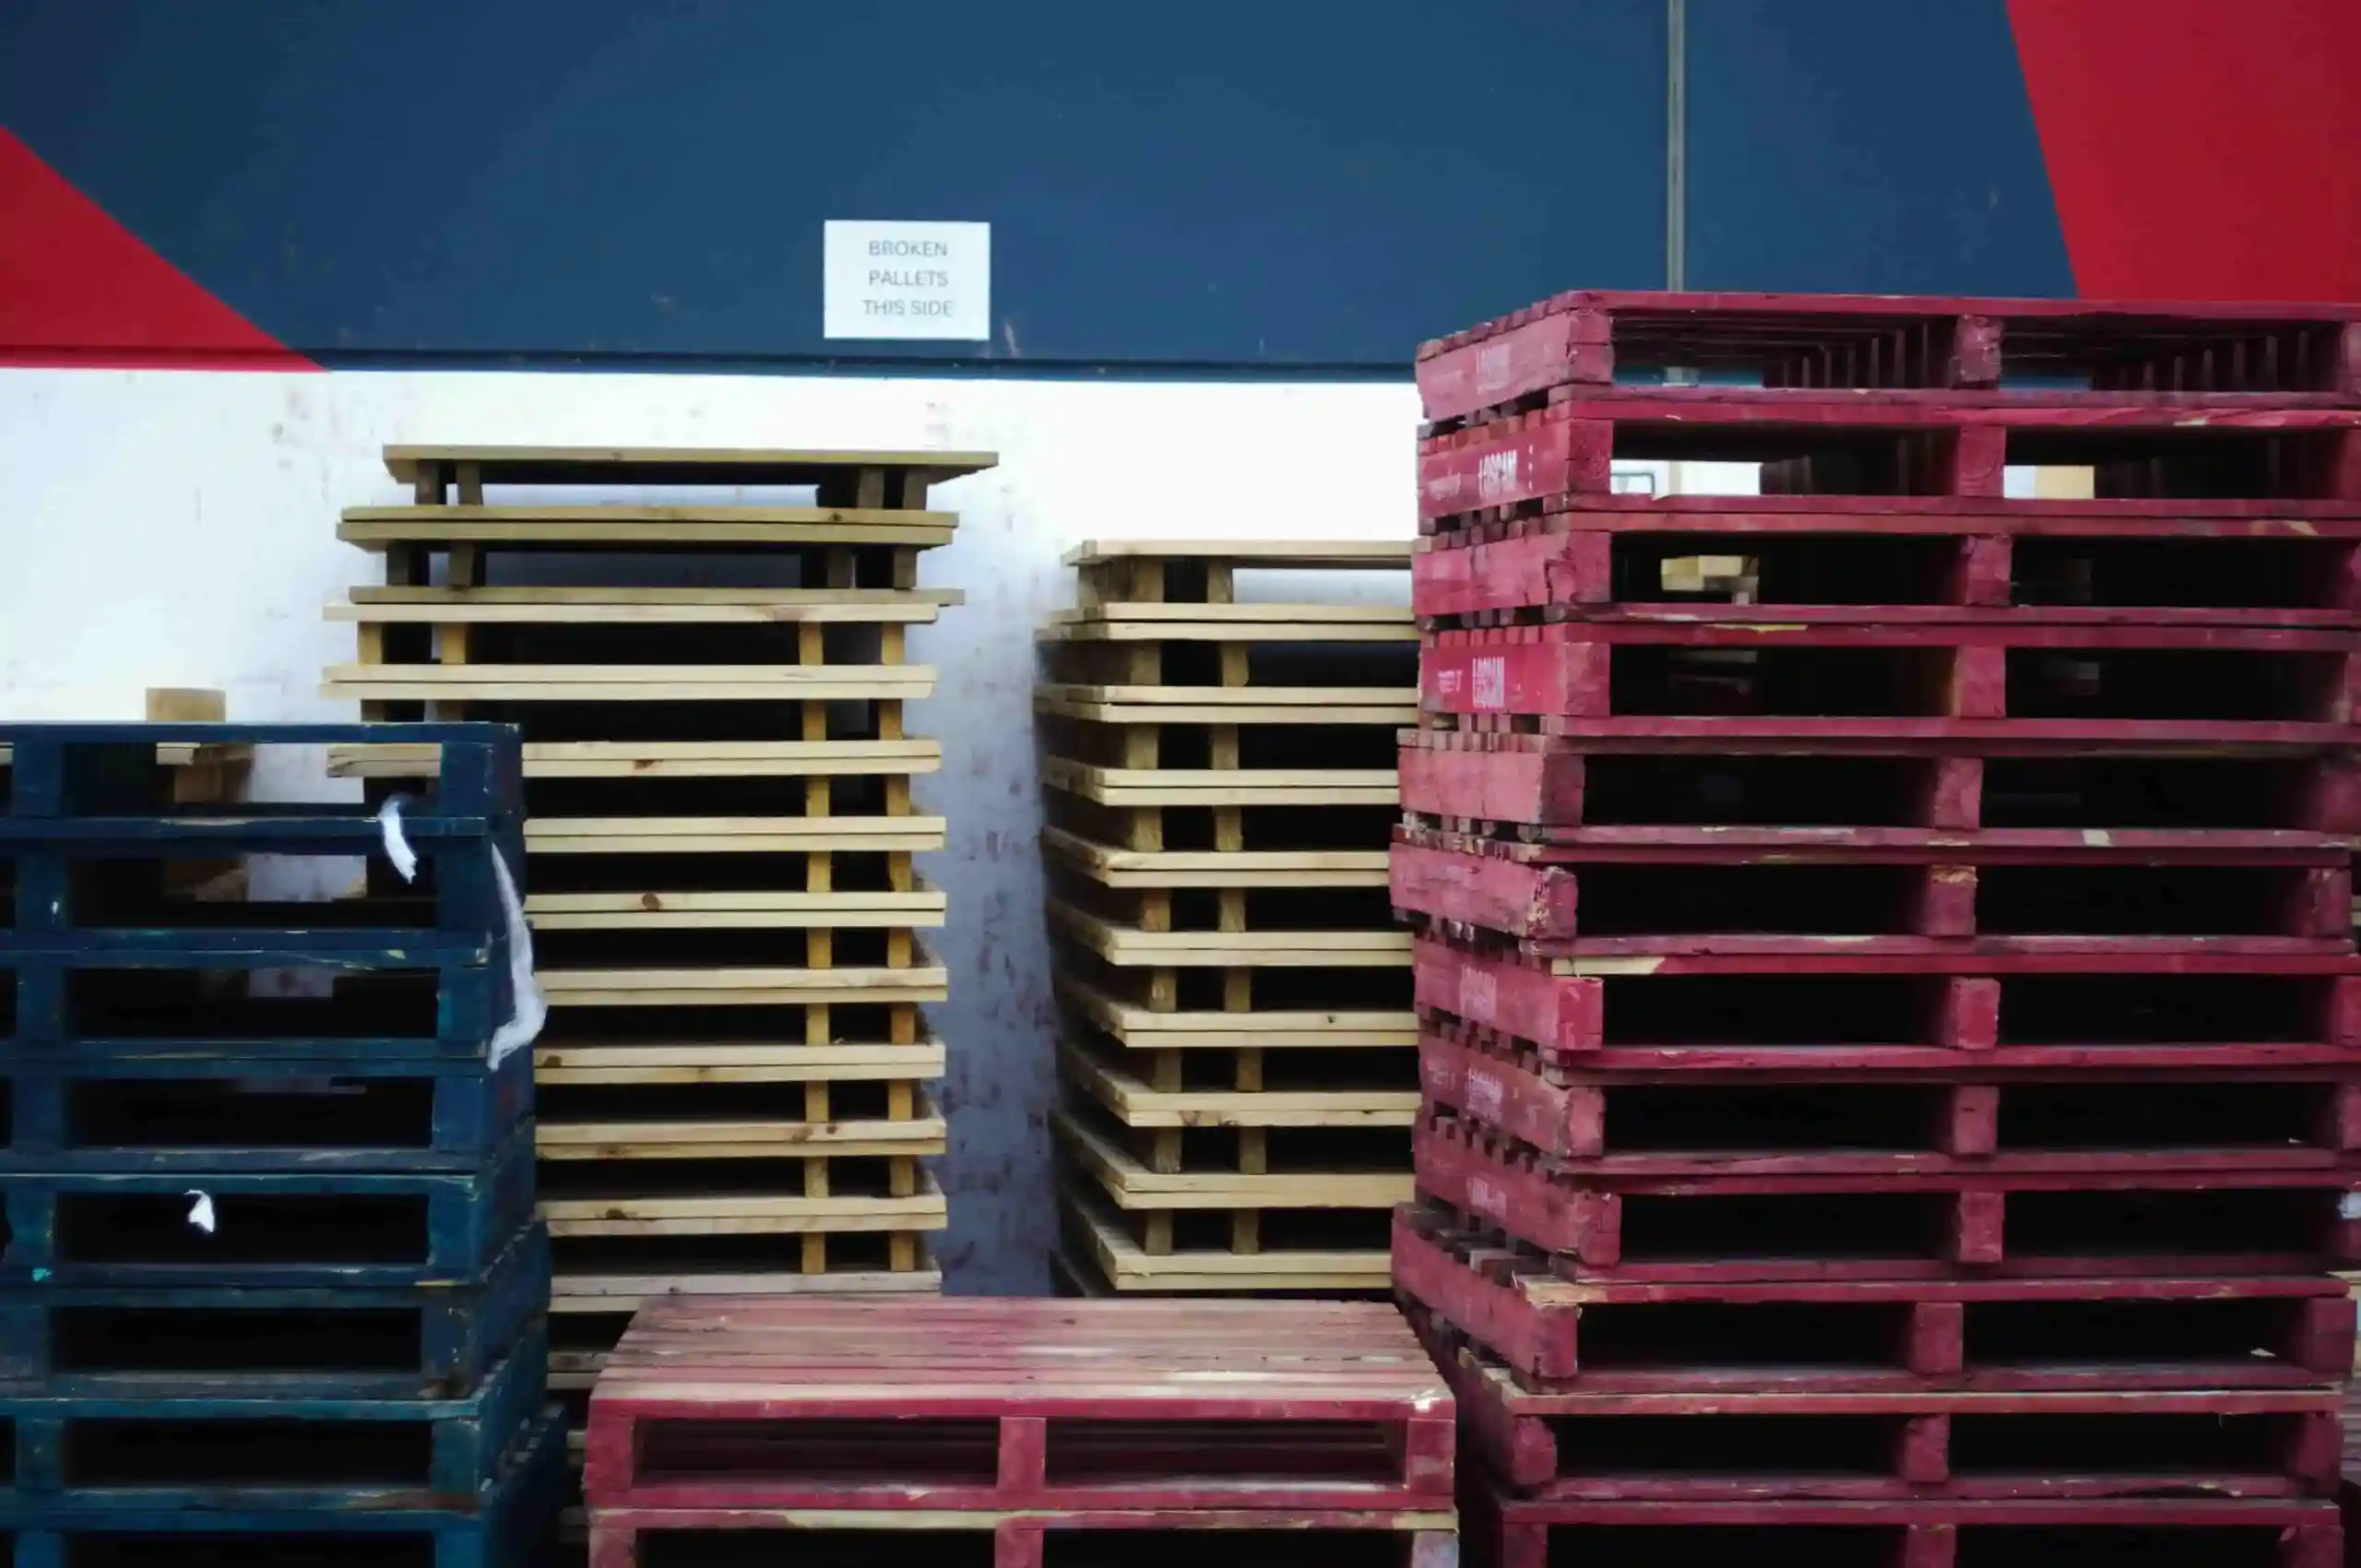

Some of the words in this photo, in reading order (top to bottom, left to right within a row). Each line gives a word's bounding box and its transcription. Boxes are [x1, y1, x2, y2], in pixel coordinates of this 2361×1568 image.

[869, 240, 947, 257] BROKEN
[869, 269, 949, 287] PALLETS
[862, 299, 905, 315] THIS
[910, 300, 955, 316] SIDE
